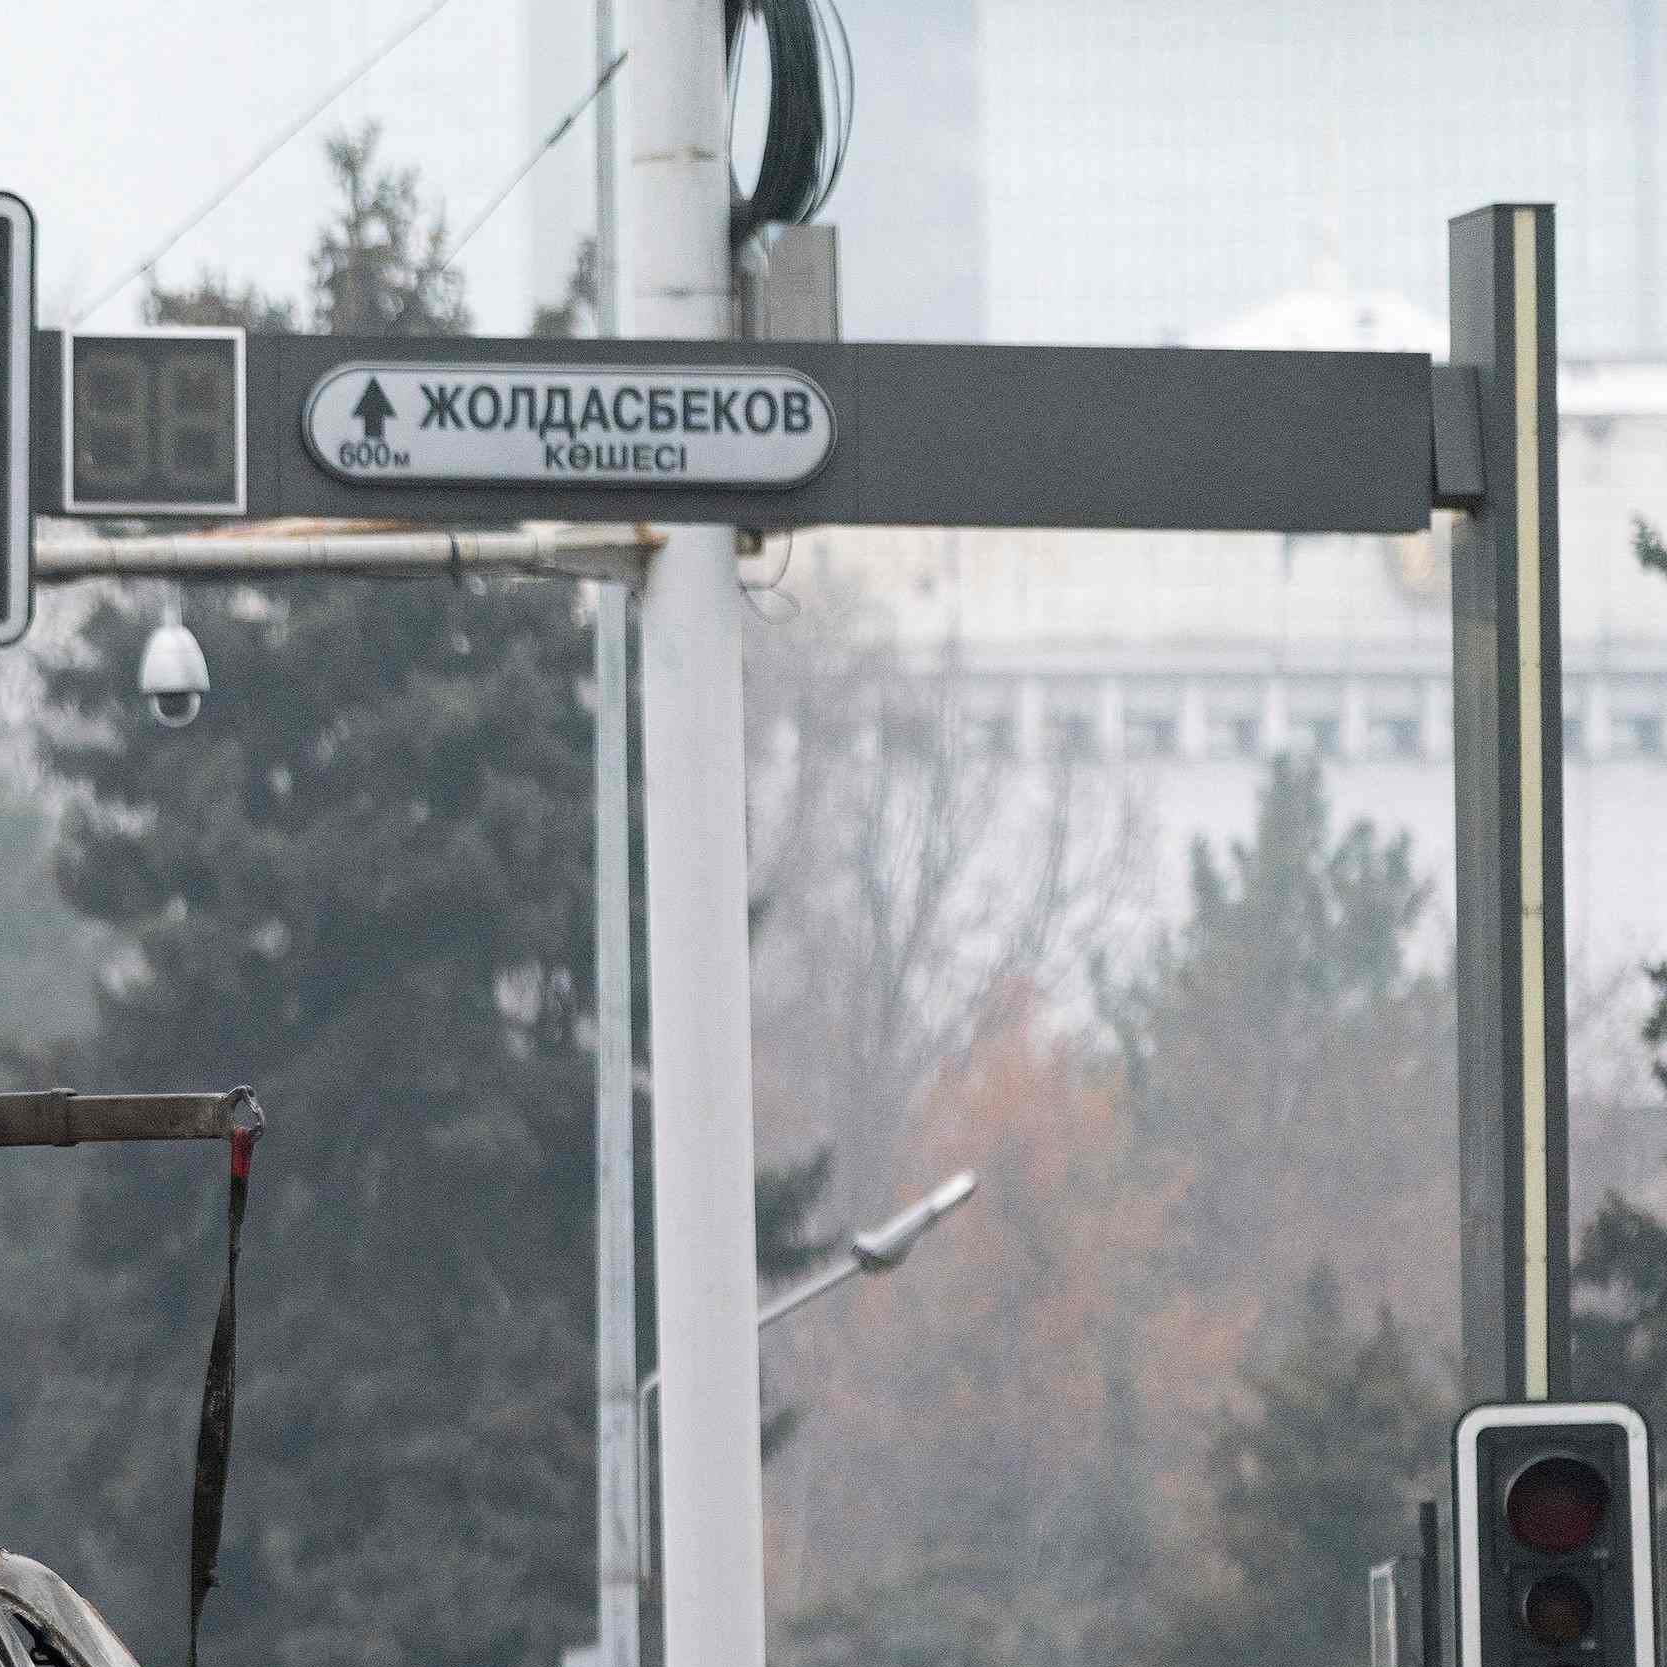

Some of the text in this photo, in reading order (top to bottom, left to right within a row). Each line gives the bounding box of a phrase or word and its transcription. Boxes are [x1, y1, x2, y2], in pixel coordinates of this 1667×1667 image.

[419, 383, 813, 440] ЖОЛДАСБЕКОВ
[338, 442, 411, 470] 600м
[544, 443, 687, 473] КӨШЕСІ
